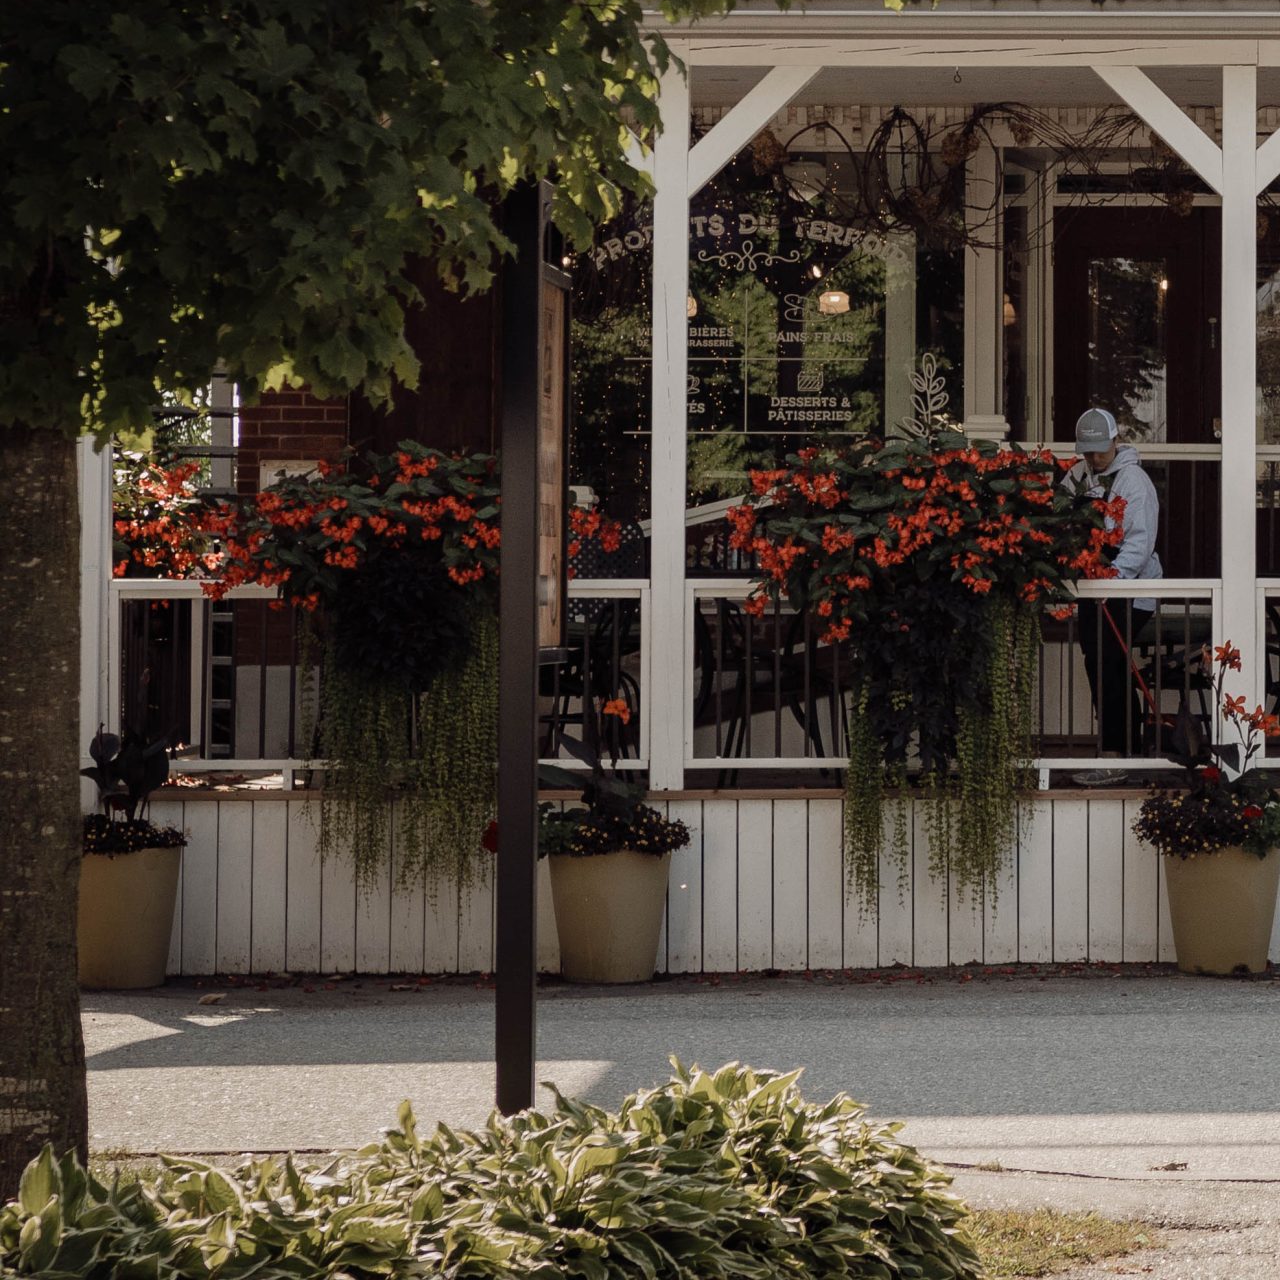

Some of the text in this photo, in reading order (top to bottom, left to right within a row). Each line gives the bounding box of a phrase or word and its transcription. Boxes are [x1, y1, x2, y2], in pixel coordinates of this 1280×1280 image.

[689, 324, 734, 337] BIÈRES
[768, 331, 854, 343] PAINS FRAIS
[688, 339, 734, 348] RASSERIE
[770, 396, 851, 408] DESSERTS &
[767, 407, 852, 422] PÂTISSERIES
